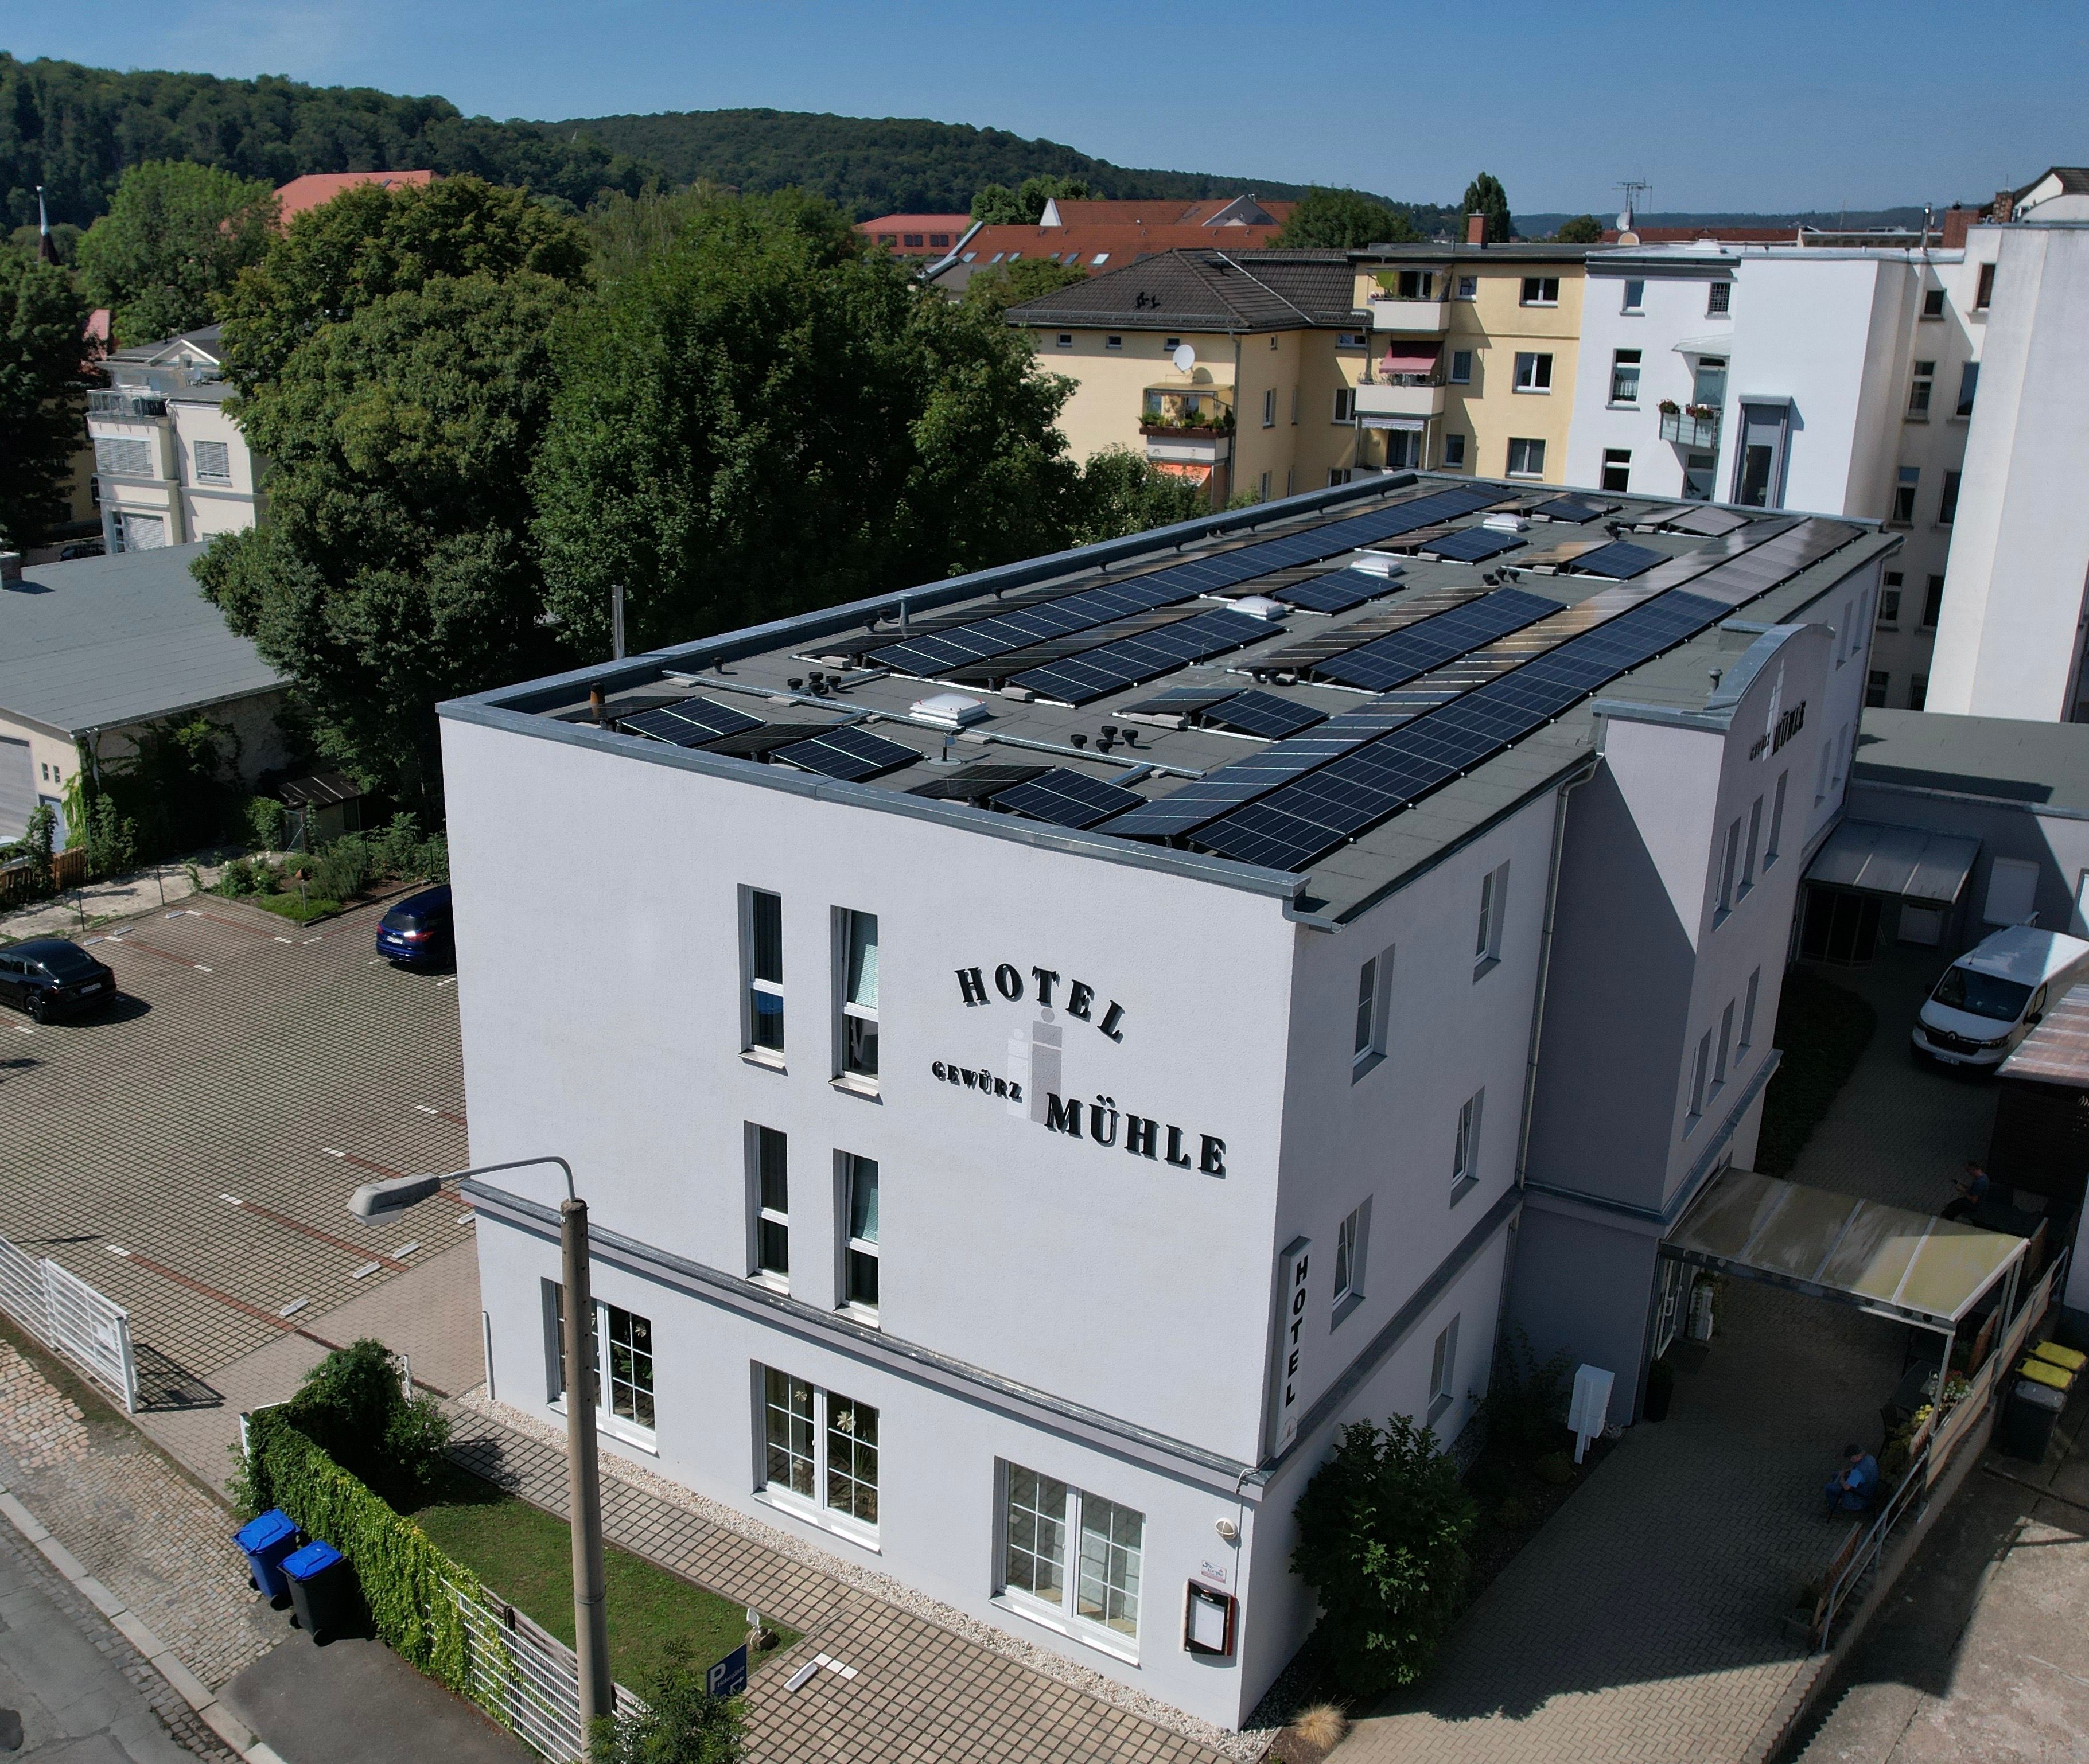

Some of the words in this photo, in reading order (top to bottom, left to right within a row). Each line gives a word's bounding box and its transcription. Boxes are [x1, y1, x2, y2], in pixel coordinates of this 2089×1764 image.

[954, 963, 1125, 1041] HOTEL
[931, 1061, 1022, 1100] GEWÜRZ
[1044, 1094, 1226, 1176] MÜHLE
[1285, 1255, 1309, 1408] HOTEL
[710, 1662, 726, 1693] P
